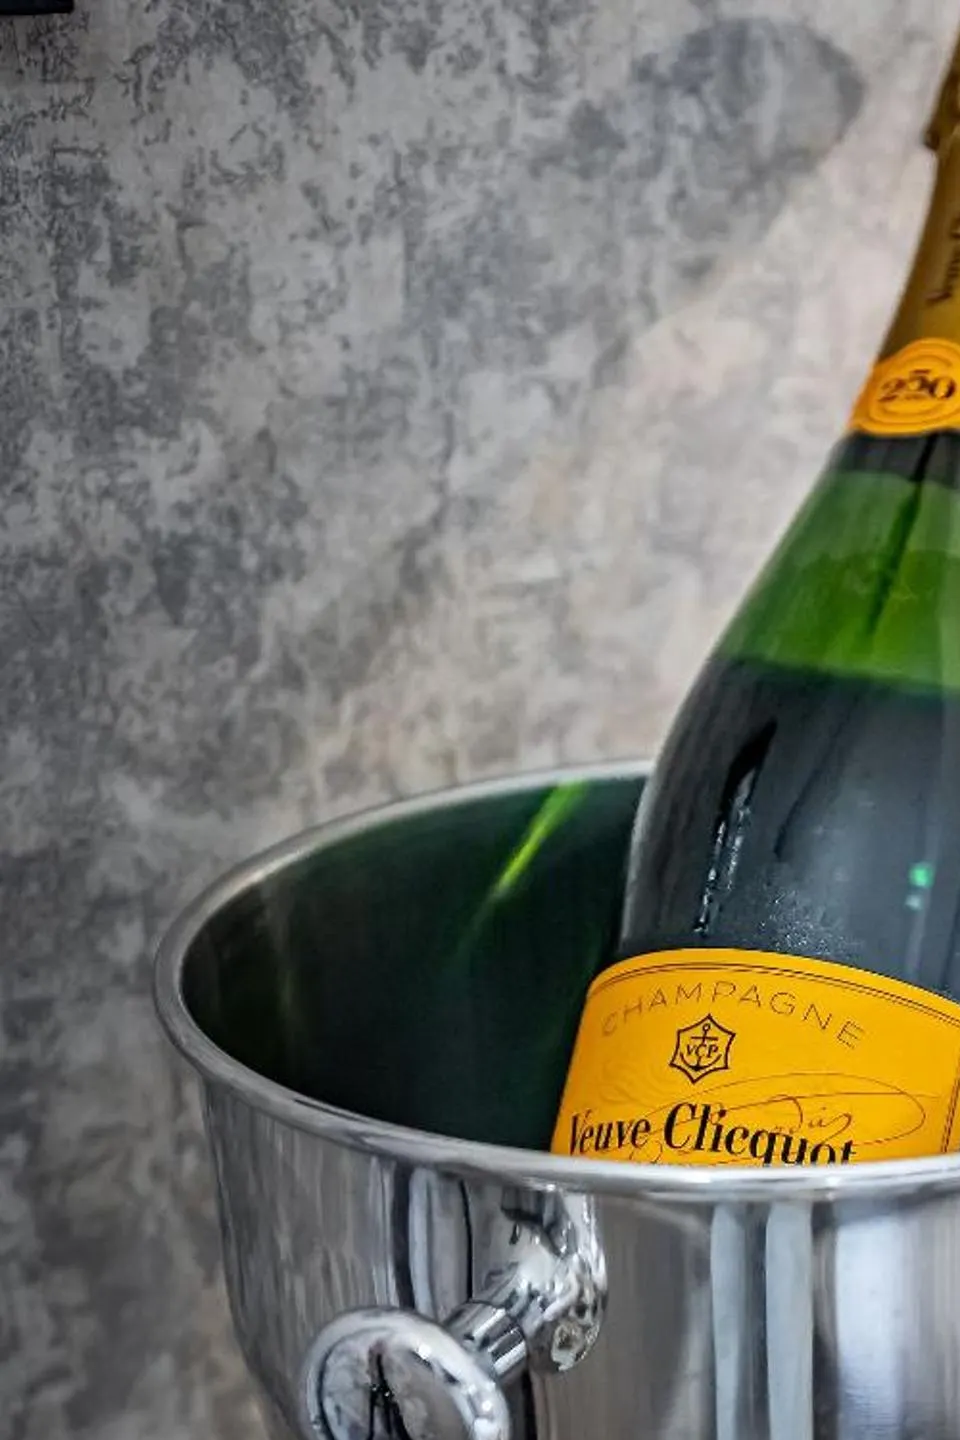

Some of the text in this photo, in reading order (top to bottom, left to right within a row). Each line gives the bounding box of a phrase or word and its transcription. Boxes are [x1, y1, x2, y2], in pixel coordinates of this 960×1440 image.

[878, 369, 957, 402] 250
[602, 980, 865, 1049] CHAMPAGNE
[569, 1109, 651, 1156] Veuve
[663, 1100, 857, 1167] Clicquot
